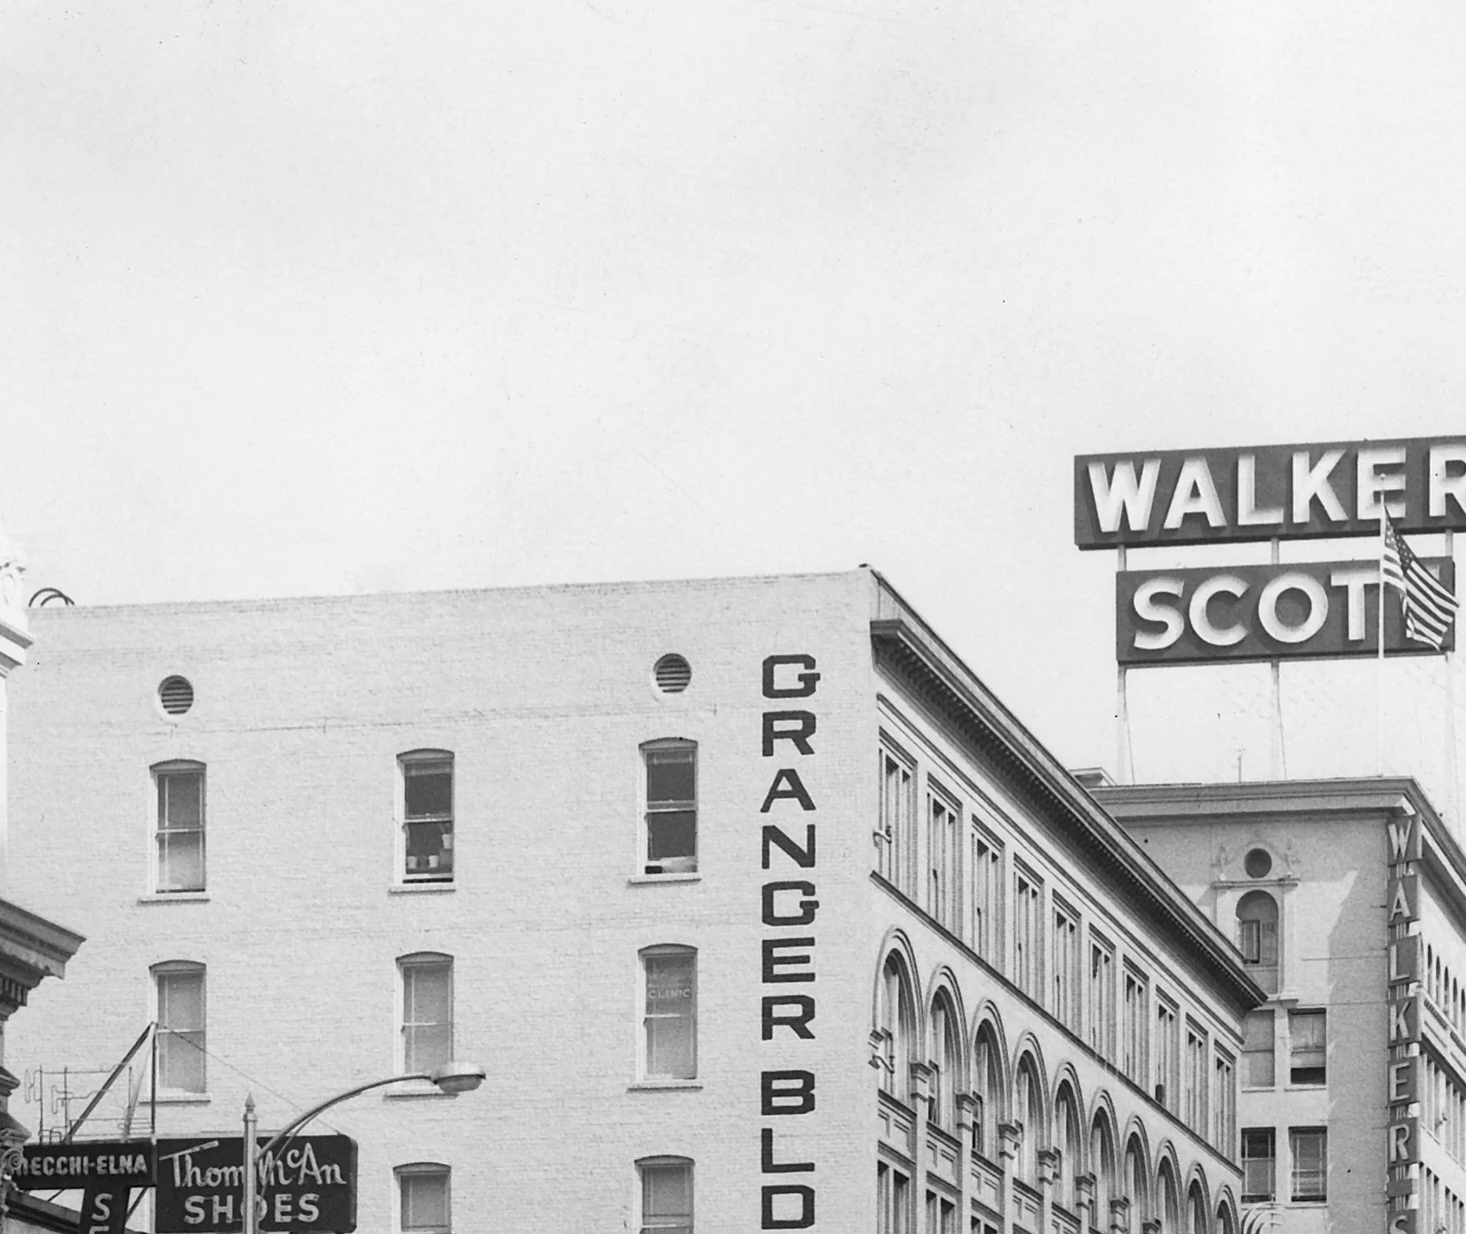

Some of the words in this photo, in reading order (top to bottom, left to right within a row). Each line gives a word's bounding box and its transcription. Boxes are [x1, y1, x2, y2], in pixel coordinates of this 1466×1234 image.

[1133, 567, 1440, 650] SCOT
[760, 654, 820, 1041] GRANGER
[1388, 819, 1413, 1163] WALKER
[184, 1192, 321, 1225] SHOES
